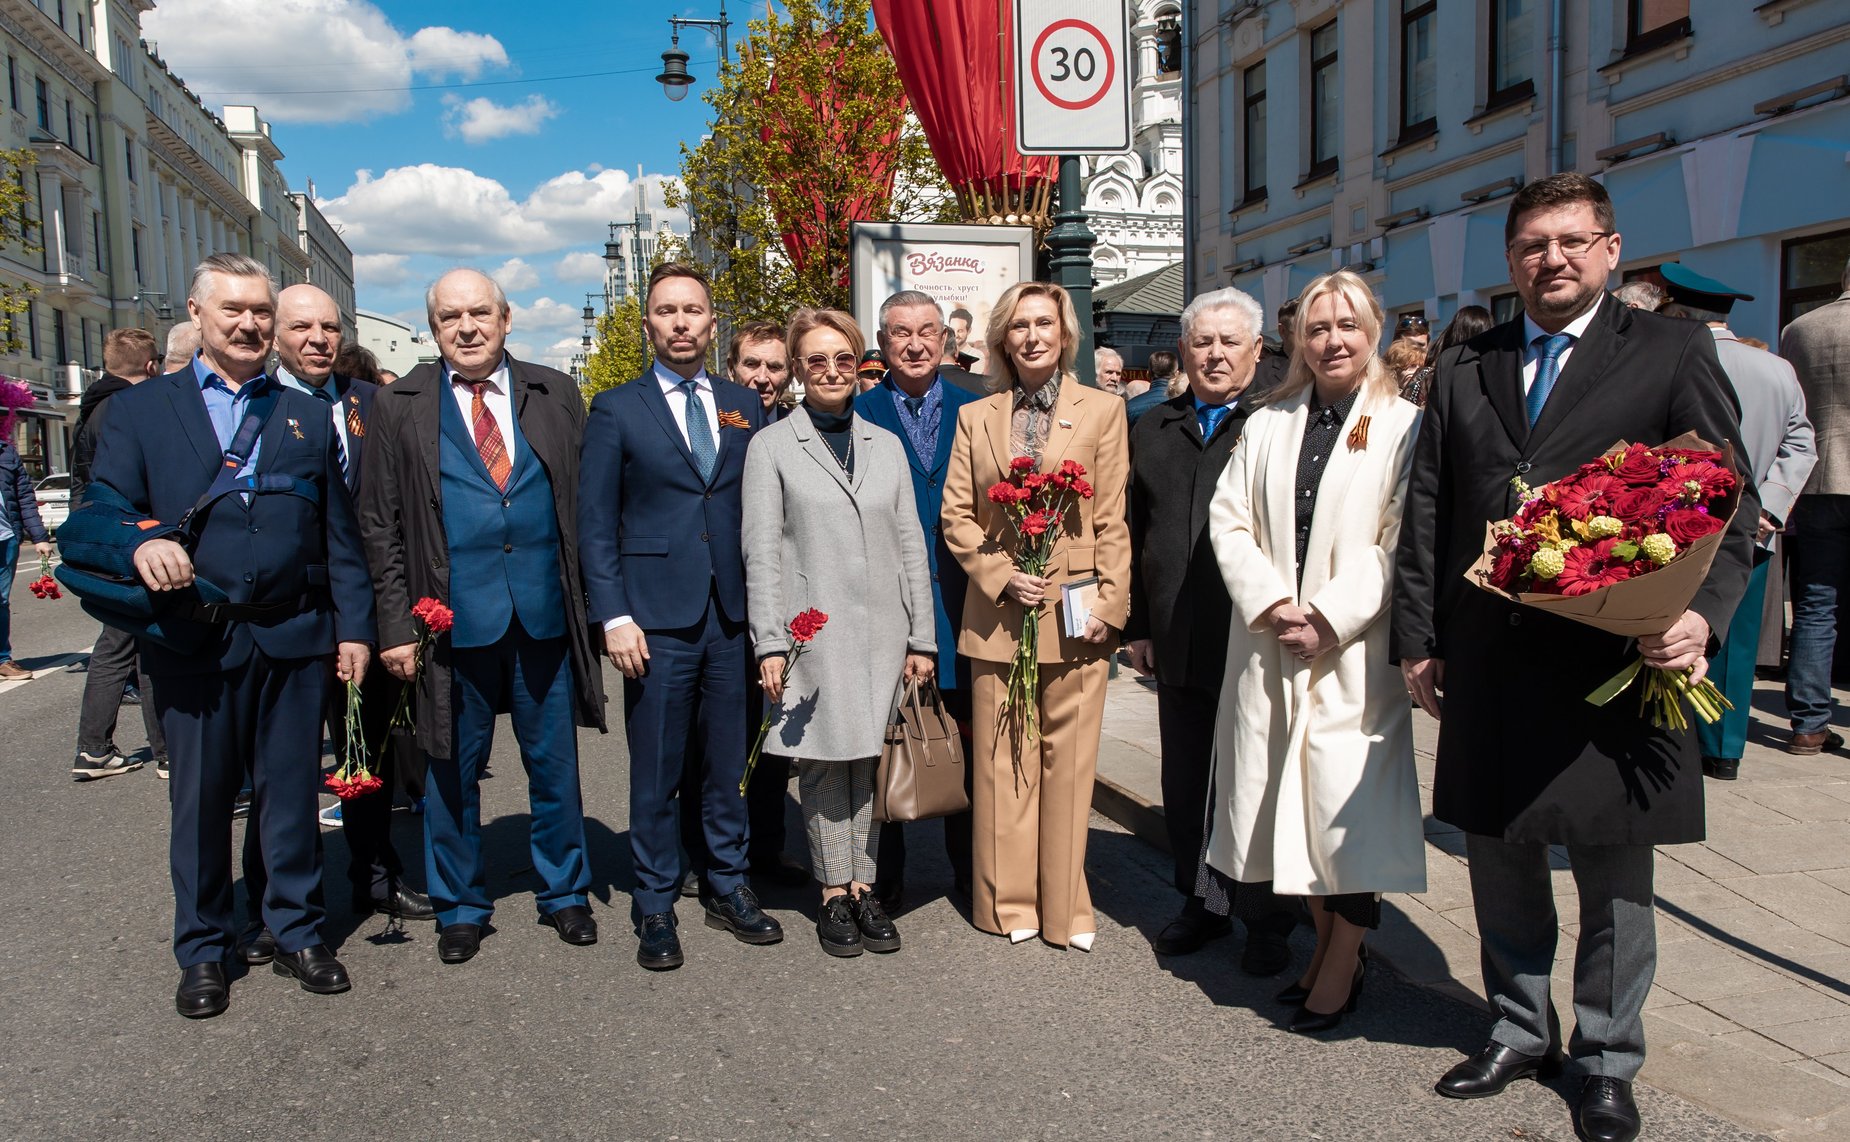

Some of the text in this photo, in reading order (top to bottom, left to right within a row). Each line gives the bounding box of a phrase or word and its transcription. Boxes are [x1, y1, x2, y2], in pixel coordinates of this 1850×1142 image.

[1050, 47, 1095, 81] 30
[907, 252, 984, 275] Вязанка
[914, 284, 979, 292] Сочность, хруст
[934, 293, 967, 302] улыбки!
